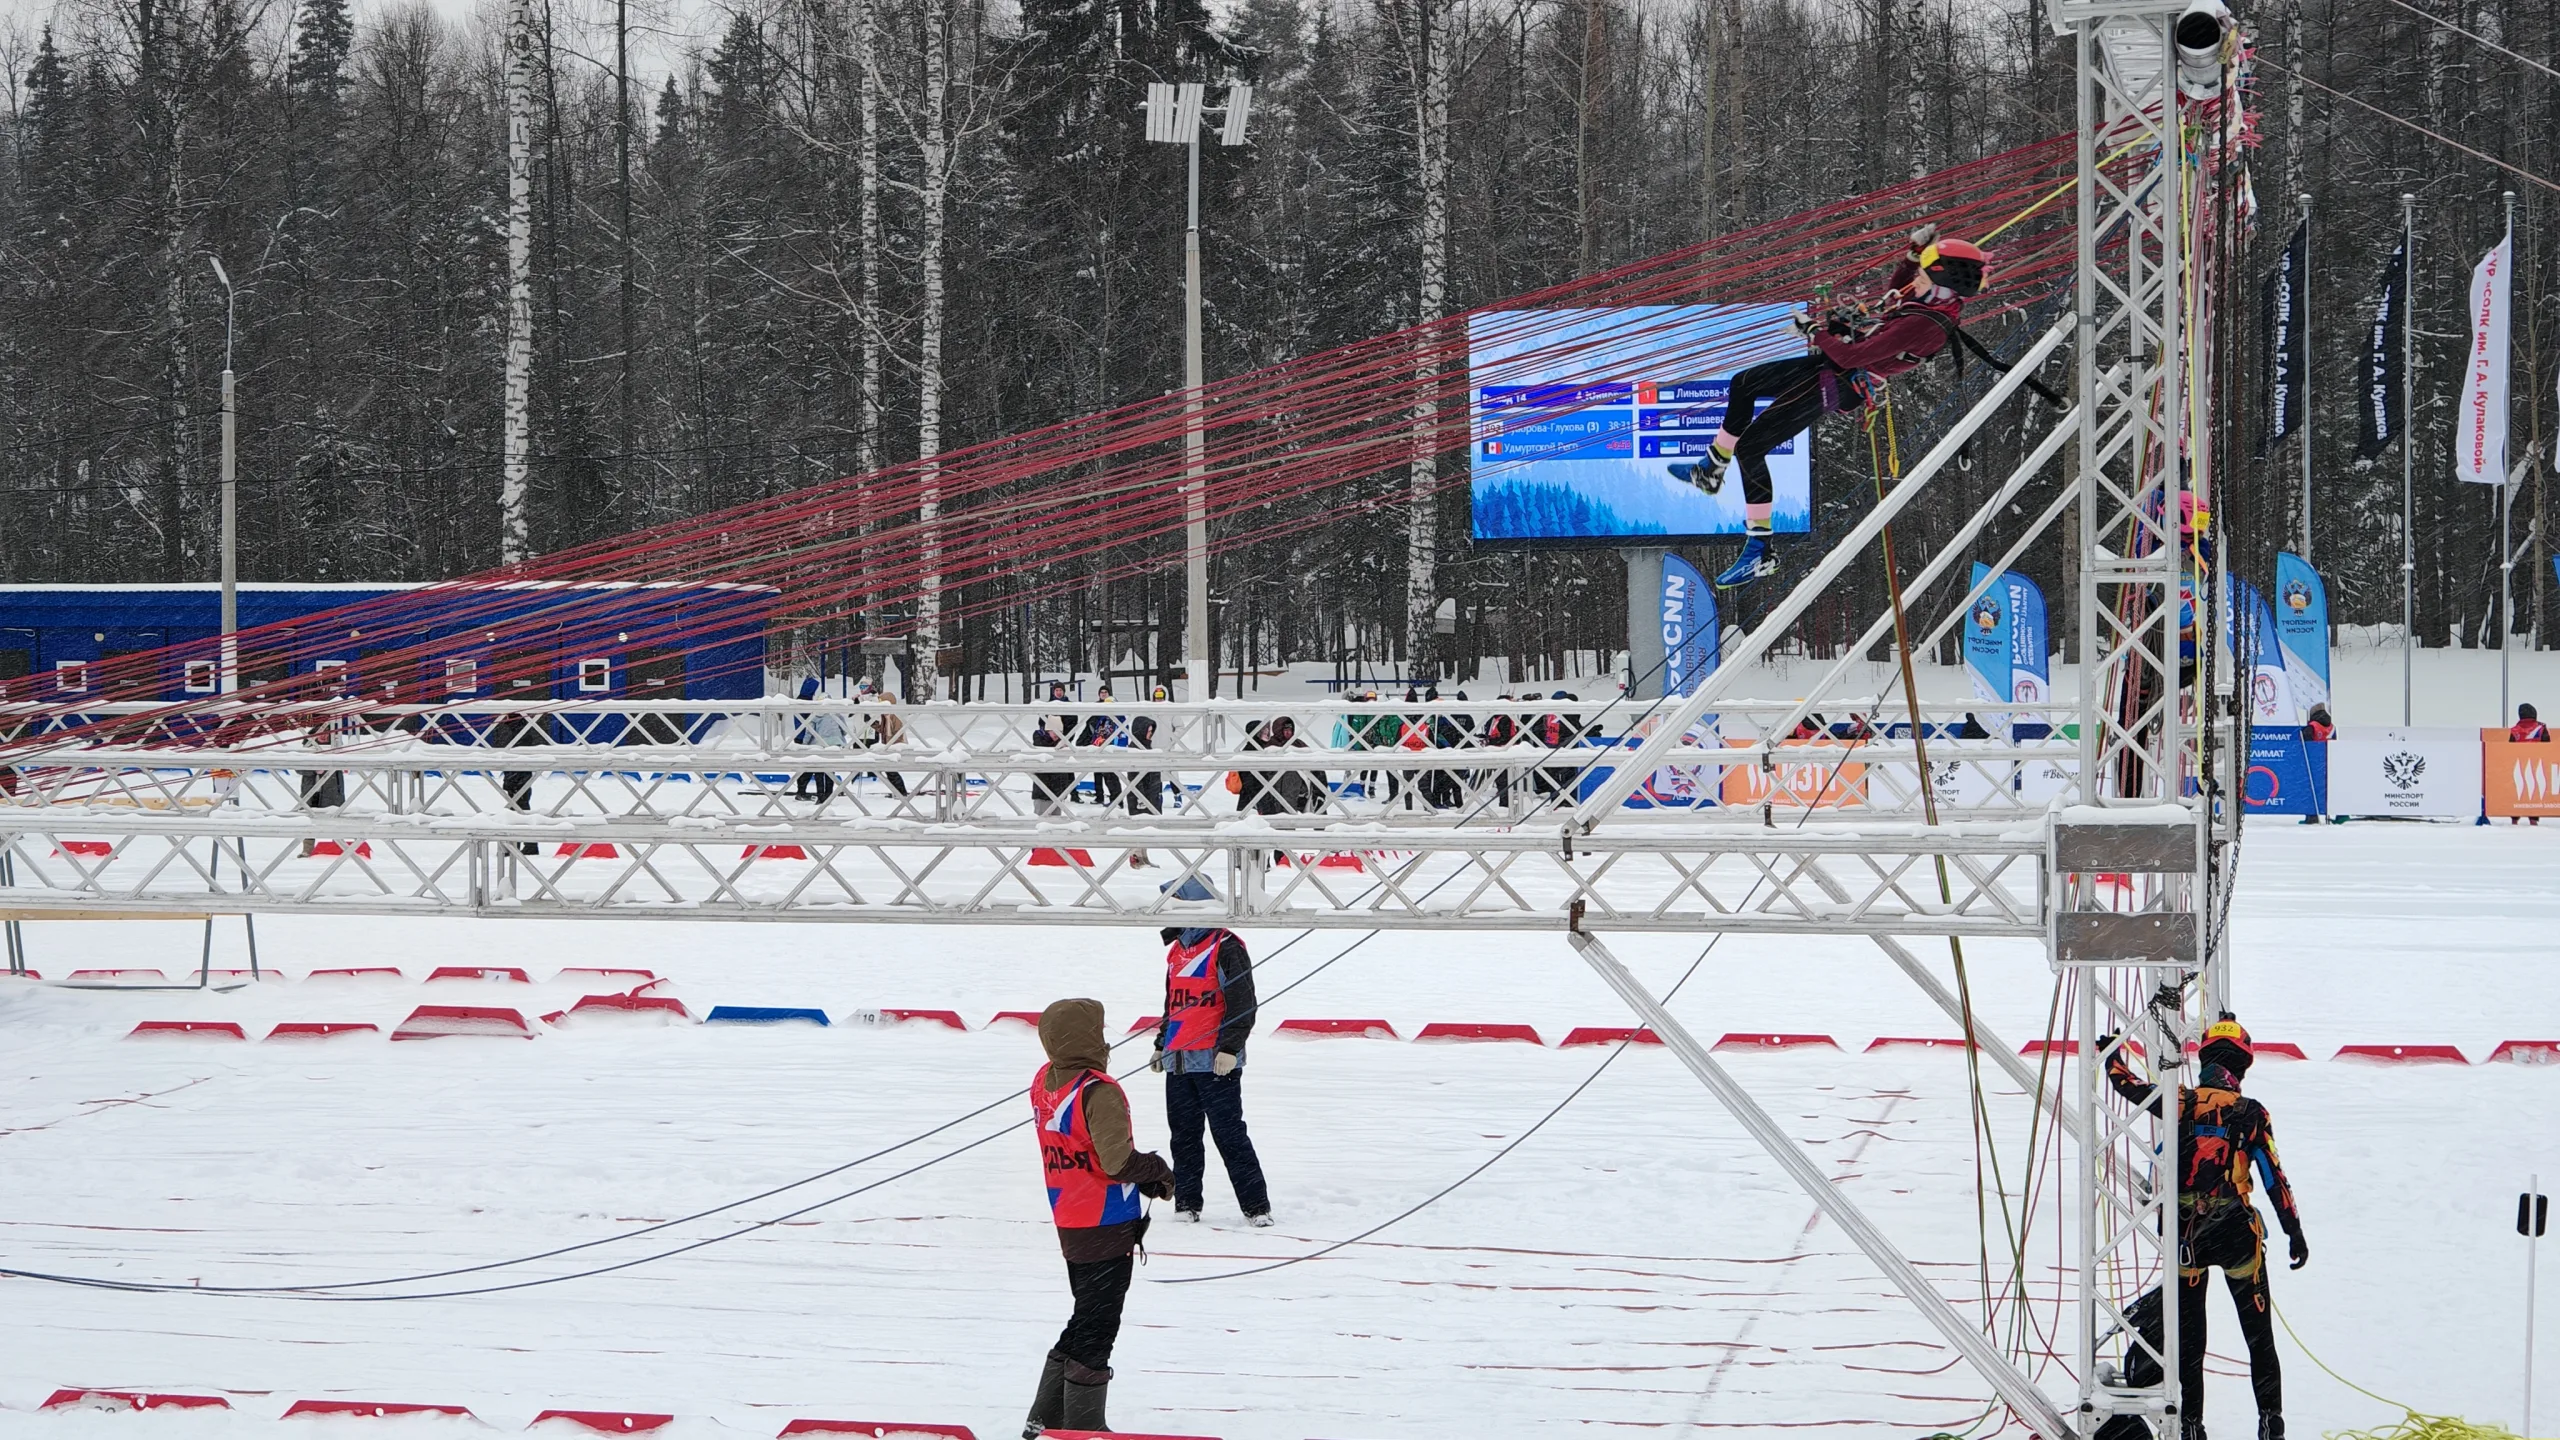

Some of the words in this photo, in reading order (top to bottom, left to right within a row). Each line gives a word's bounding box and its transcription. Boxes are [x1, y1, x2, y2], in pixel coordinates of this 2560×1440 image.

[2486, 258, 2497, 276] УР
[2277, 325, 2287, 350] им.
[2373, 325, 2384, 350] им.
[2477, 331, 2488, 355] им.
[2276, 352, 2288, 362] Г.
[2373, 352, 2385, 363] Г.
[2476, 359, 2489, 368] Г.
[2276, 366, 2288, 381] А.
[2373, 365, 2386, 381] А.
[2476, 372, 2488, 387] А.
[1644, 390, 1650, 399] 1
[1587, 421, 1600, 433] (3)
[1682, 414, 1725, 427] Гришаева
[2473, 391, 2488, 474] Кулаковой»
[1504, 441, 1556, 455] Удмуртской
[1645, 442, 1652, 452] 4
[2249, 749, 2285, 757] ЛИМАТ
[2266, 797, 2285, 806] ЛЕТ
[1170, 988, 1217, 1011] ДЬЯ
[2214, 1024, 2234, 1032] 932
